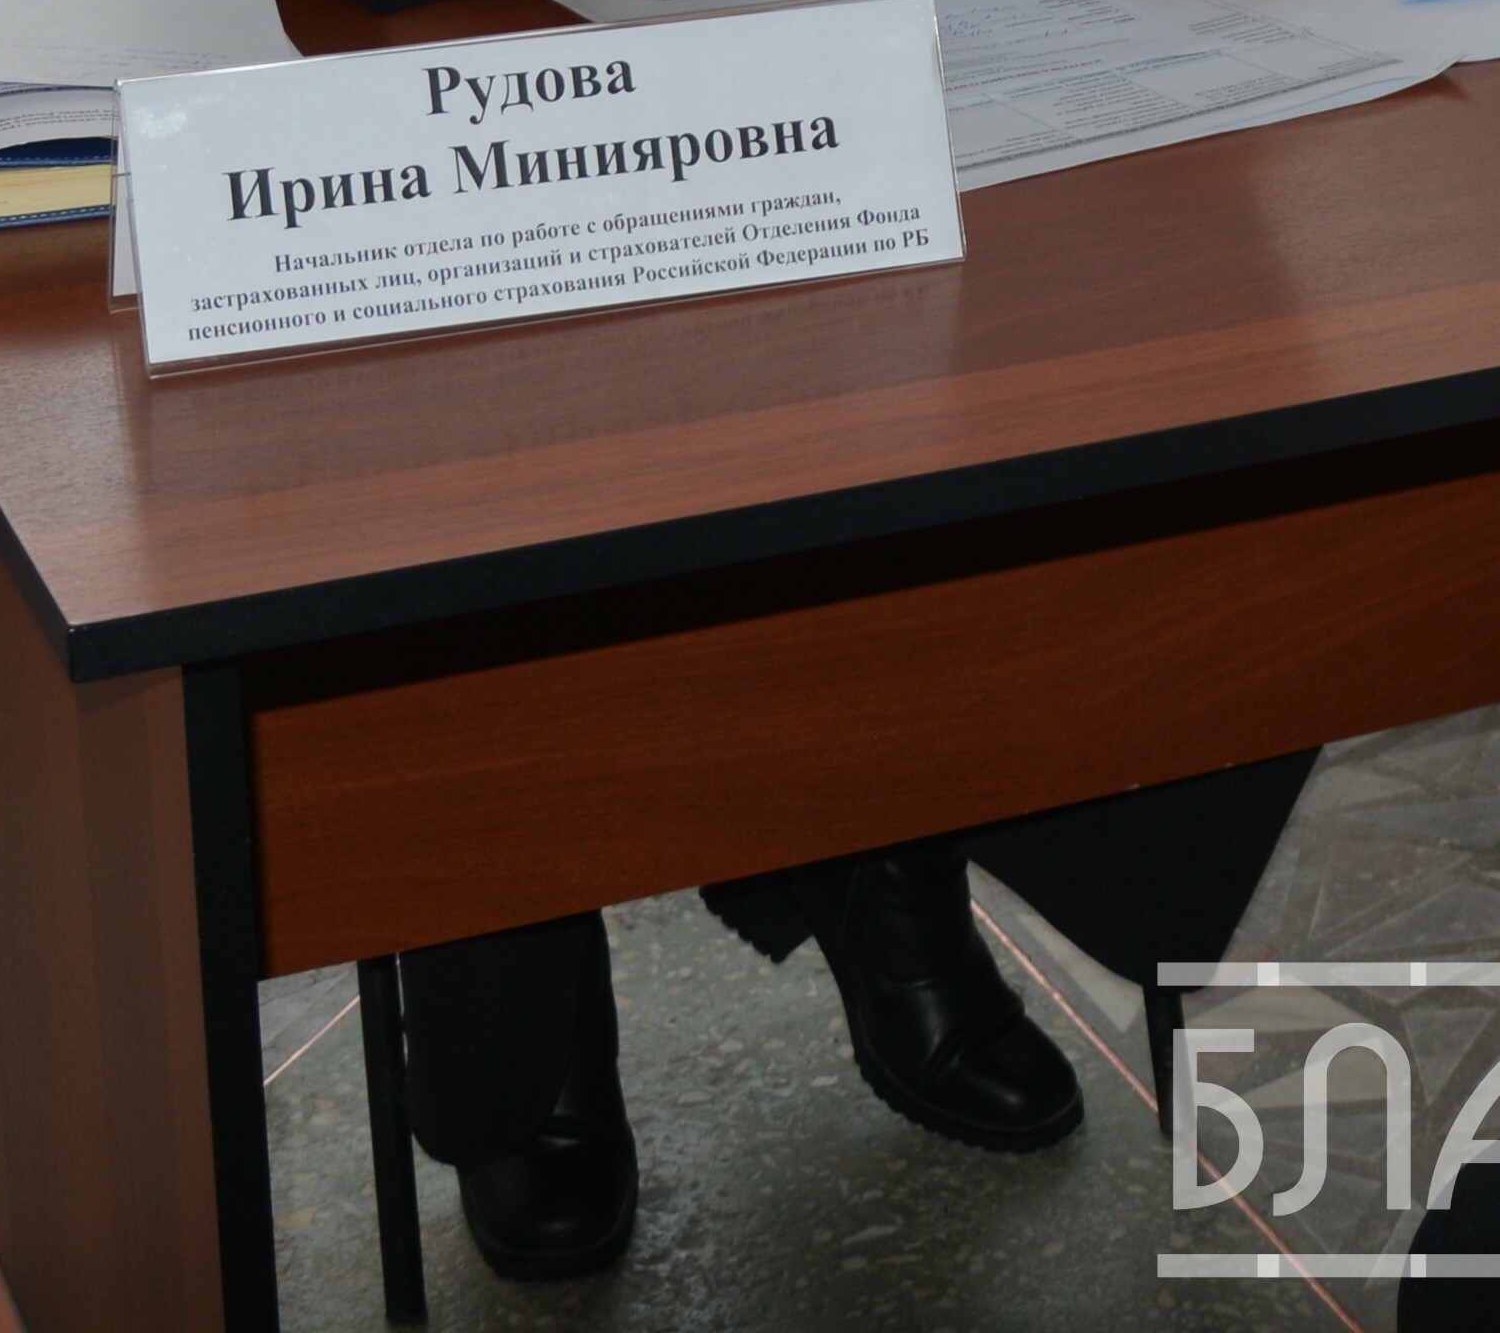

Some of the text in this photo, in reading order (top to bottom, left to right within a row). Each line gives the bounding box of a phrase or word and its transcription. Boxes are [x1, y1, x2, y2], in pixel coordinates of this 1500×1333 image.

[421, 58, 637, 125] Рудова
[222, 115, 841, 230] Ирина Минияровна
[187, 229, 930, 341] пенсионного и социального страхования Российской Федерации по РБ
[190, 206, 921, 312] застрахованных лиц, организаций и страхователей Отделения Фонда
[274, 191, 842, 273] Начальник отдела по работе с обращениями граждан,
